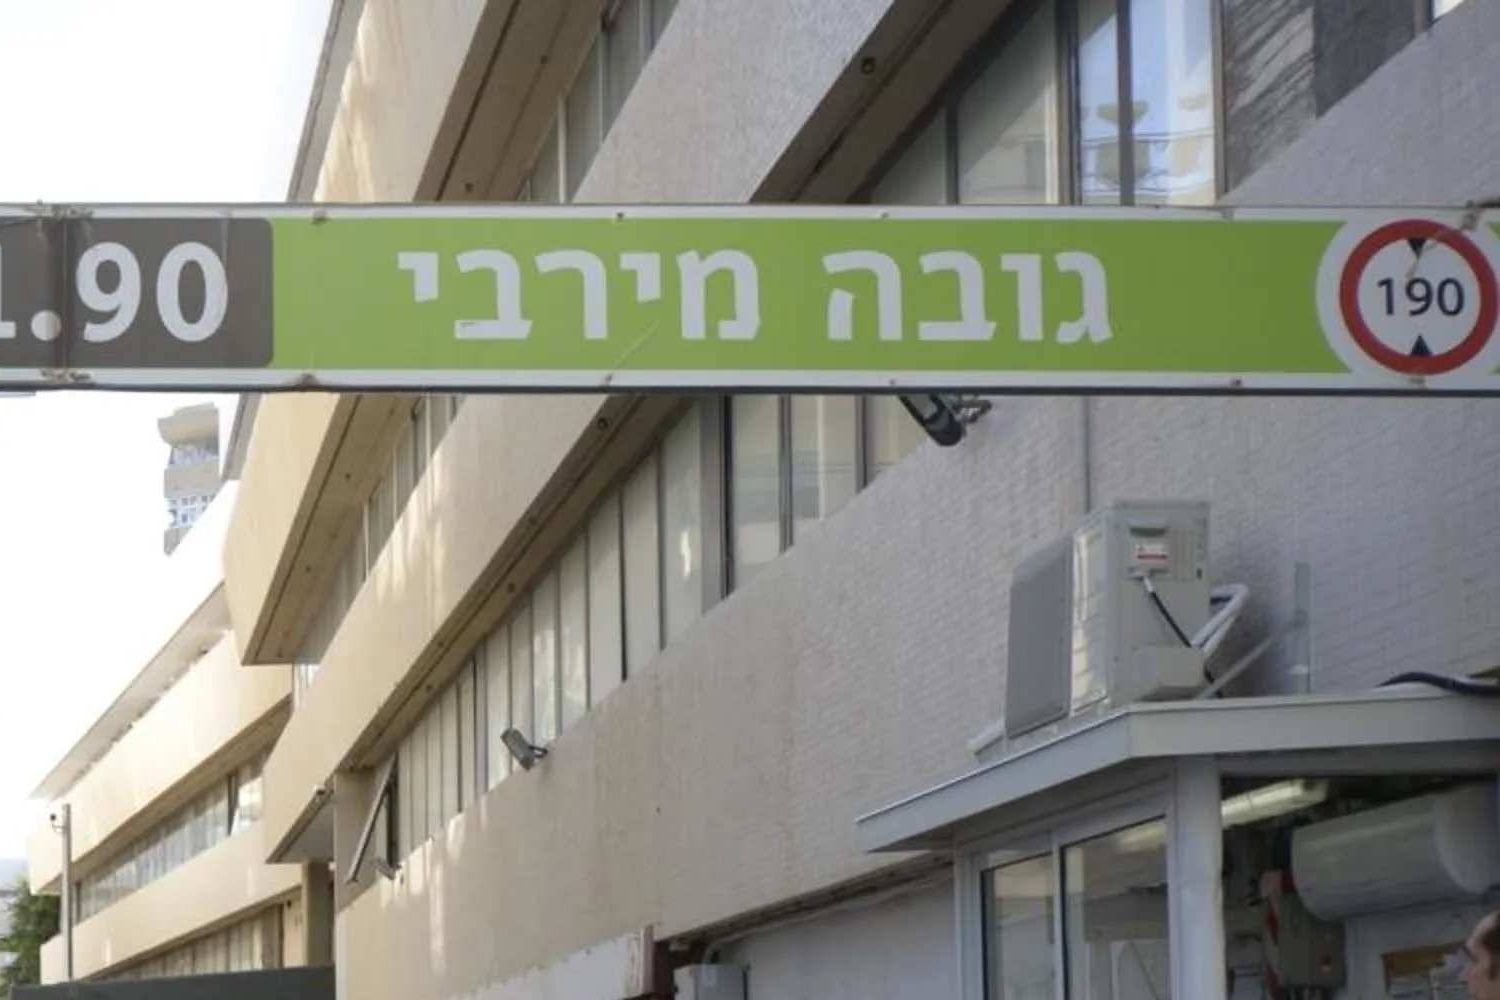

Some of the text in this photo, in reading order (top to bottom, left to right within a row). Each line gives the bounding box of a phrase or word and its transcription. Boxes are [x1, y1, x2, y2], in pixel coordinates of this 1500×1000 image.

[396, 248, 1112, 343] גובה מירבי
[1376, 276, 1466, 317] 190
